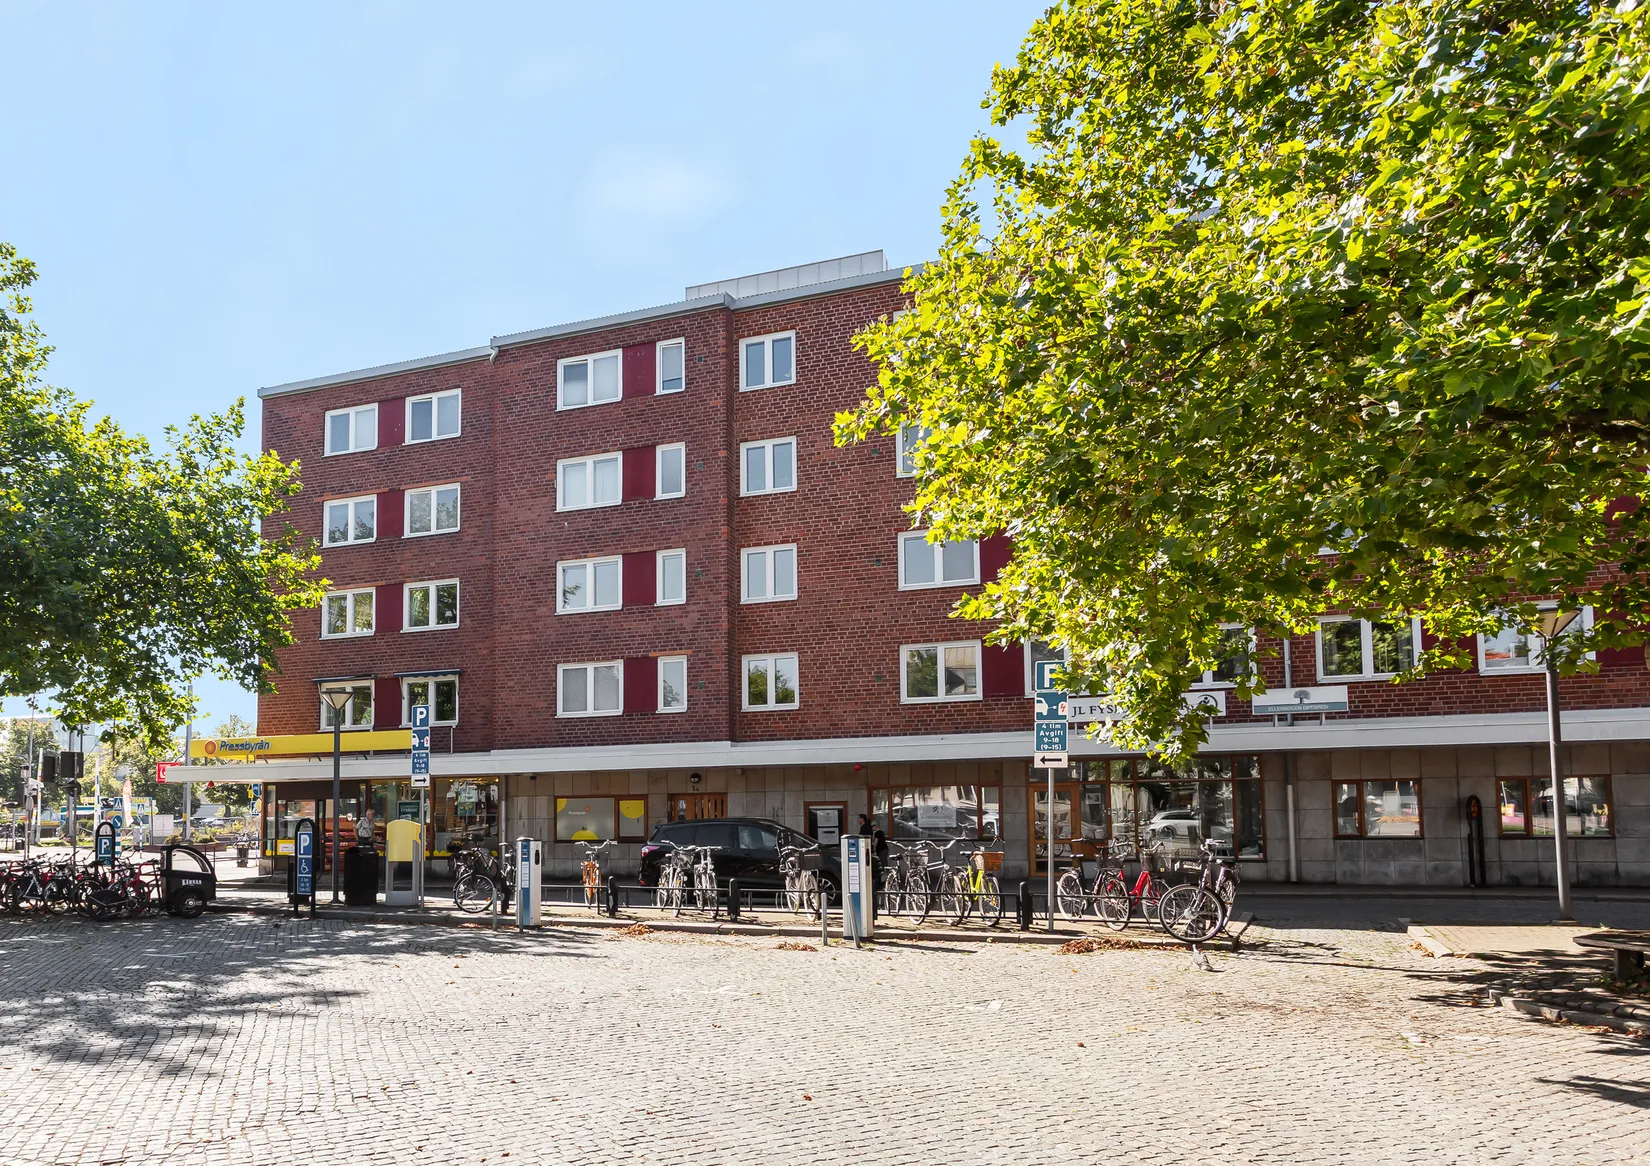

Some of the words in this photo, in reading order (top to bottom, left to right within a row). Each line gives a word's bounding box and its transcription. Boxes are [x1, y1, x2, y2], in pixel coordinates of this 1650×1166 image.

[416, 707, 427, 726] P
[1072, 706, 1086, 718] JL
[220, 739, 271, 754] Pressbyrån
[101, 839, 110, 854] P
[300, 834, 310, 854] P
